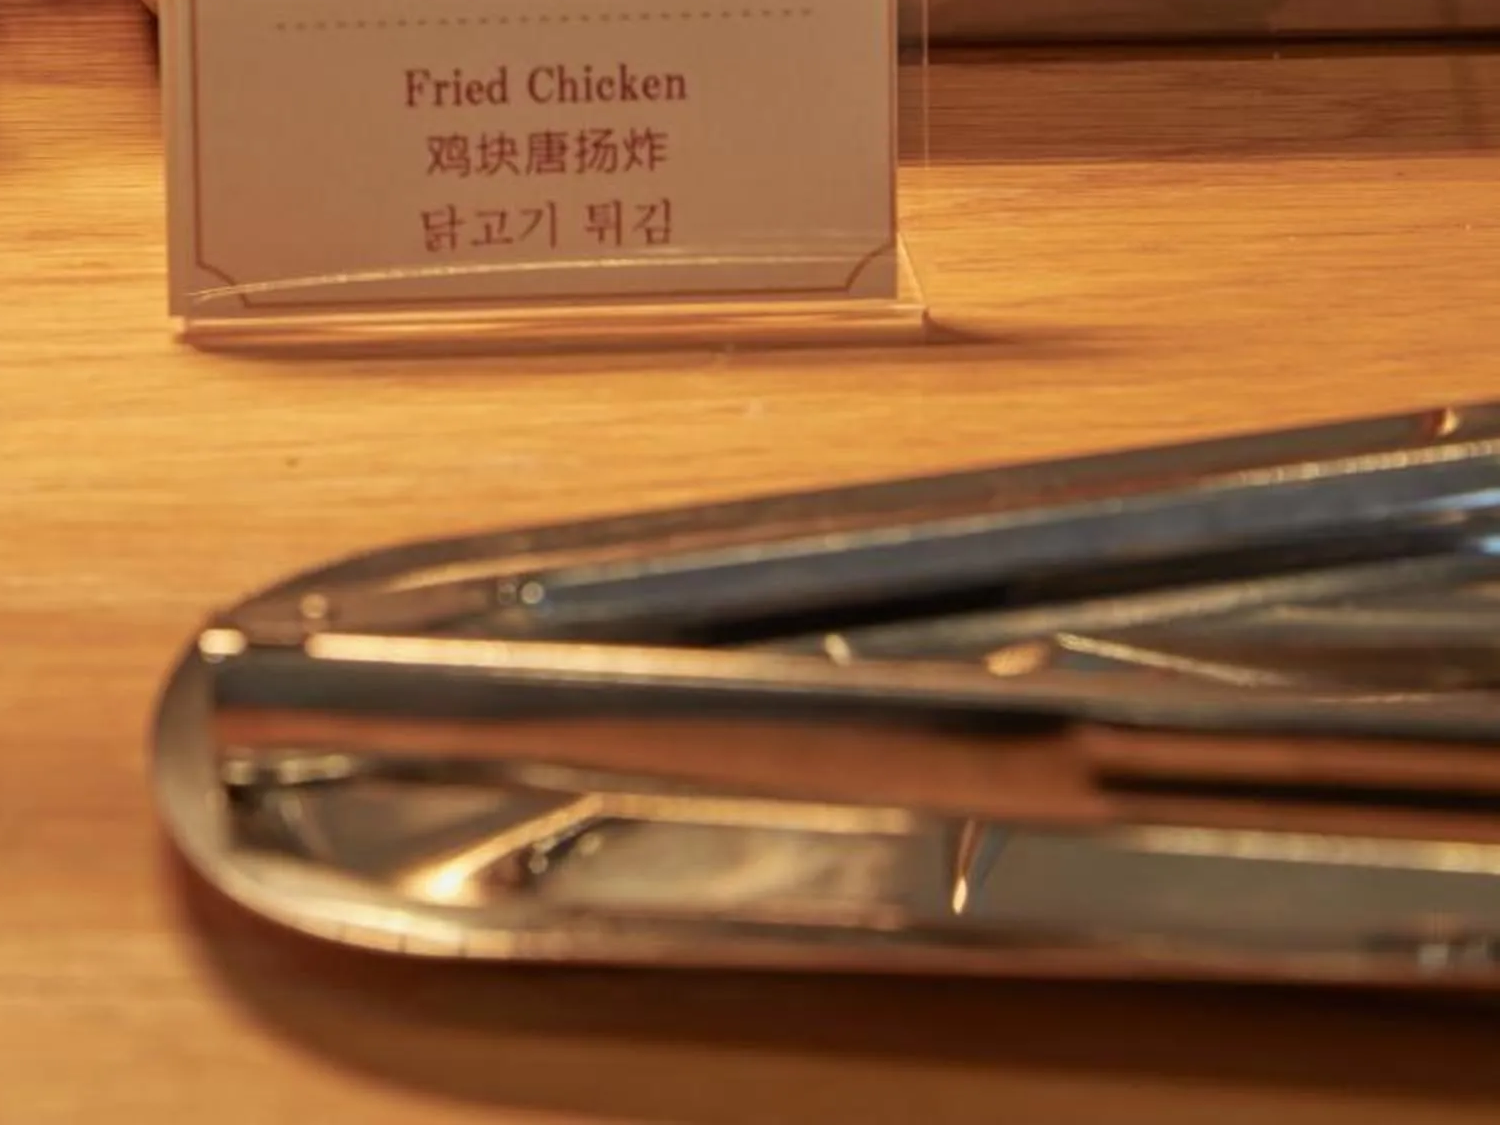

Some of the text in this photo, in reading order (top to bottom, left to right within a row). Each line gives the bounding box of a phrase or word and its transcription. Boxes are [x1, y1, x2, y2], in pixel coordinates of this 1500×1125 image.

[404, 63, 688, 108] Fried Chicken
[426, 127, 669, 178] 鸡块唐扬炸
[419, 197, 674, 253] 닭고기 튀김
